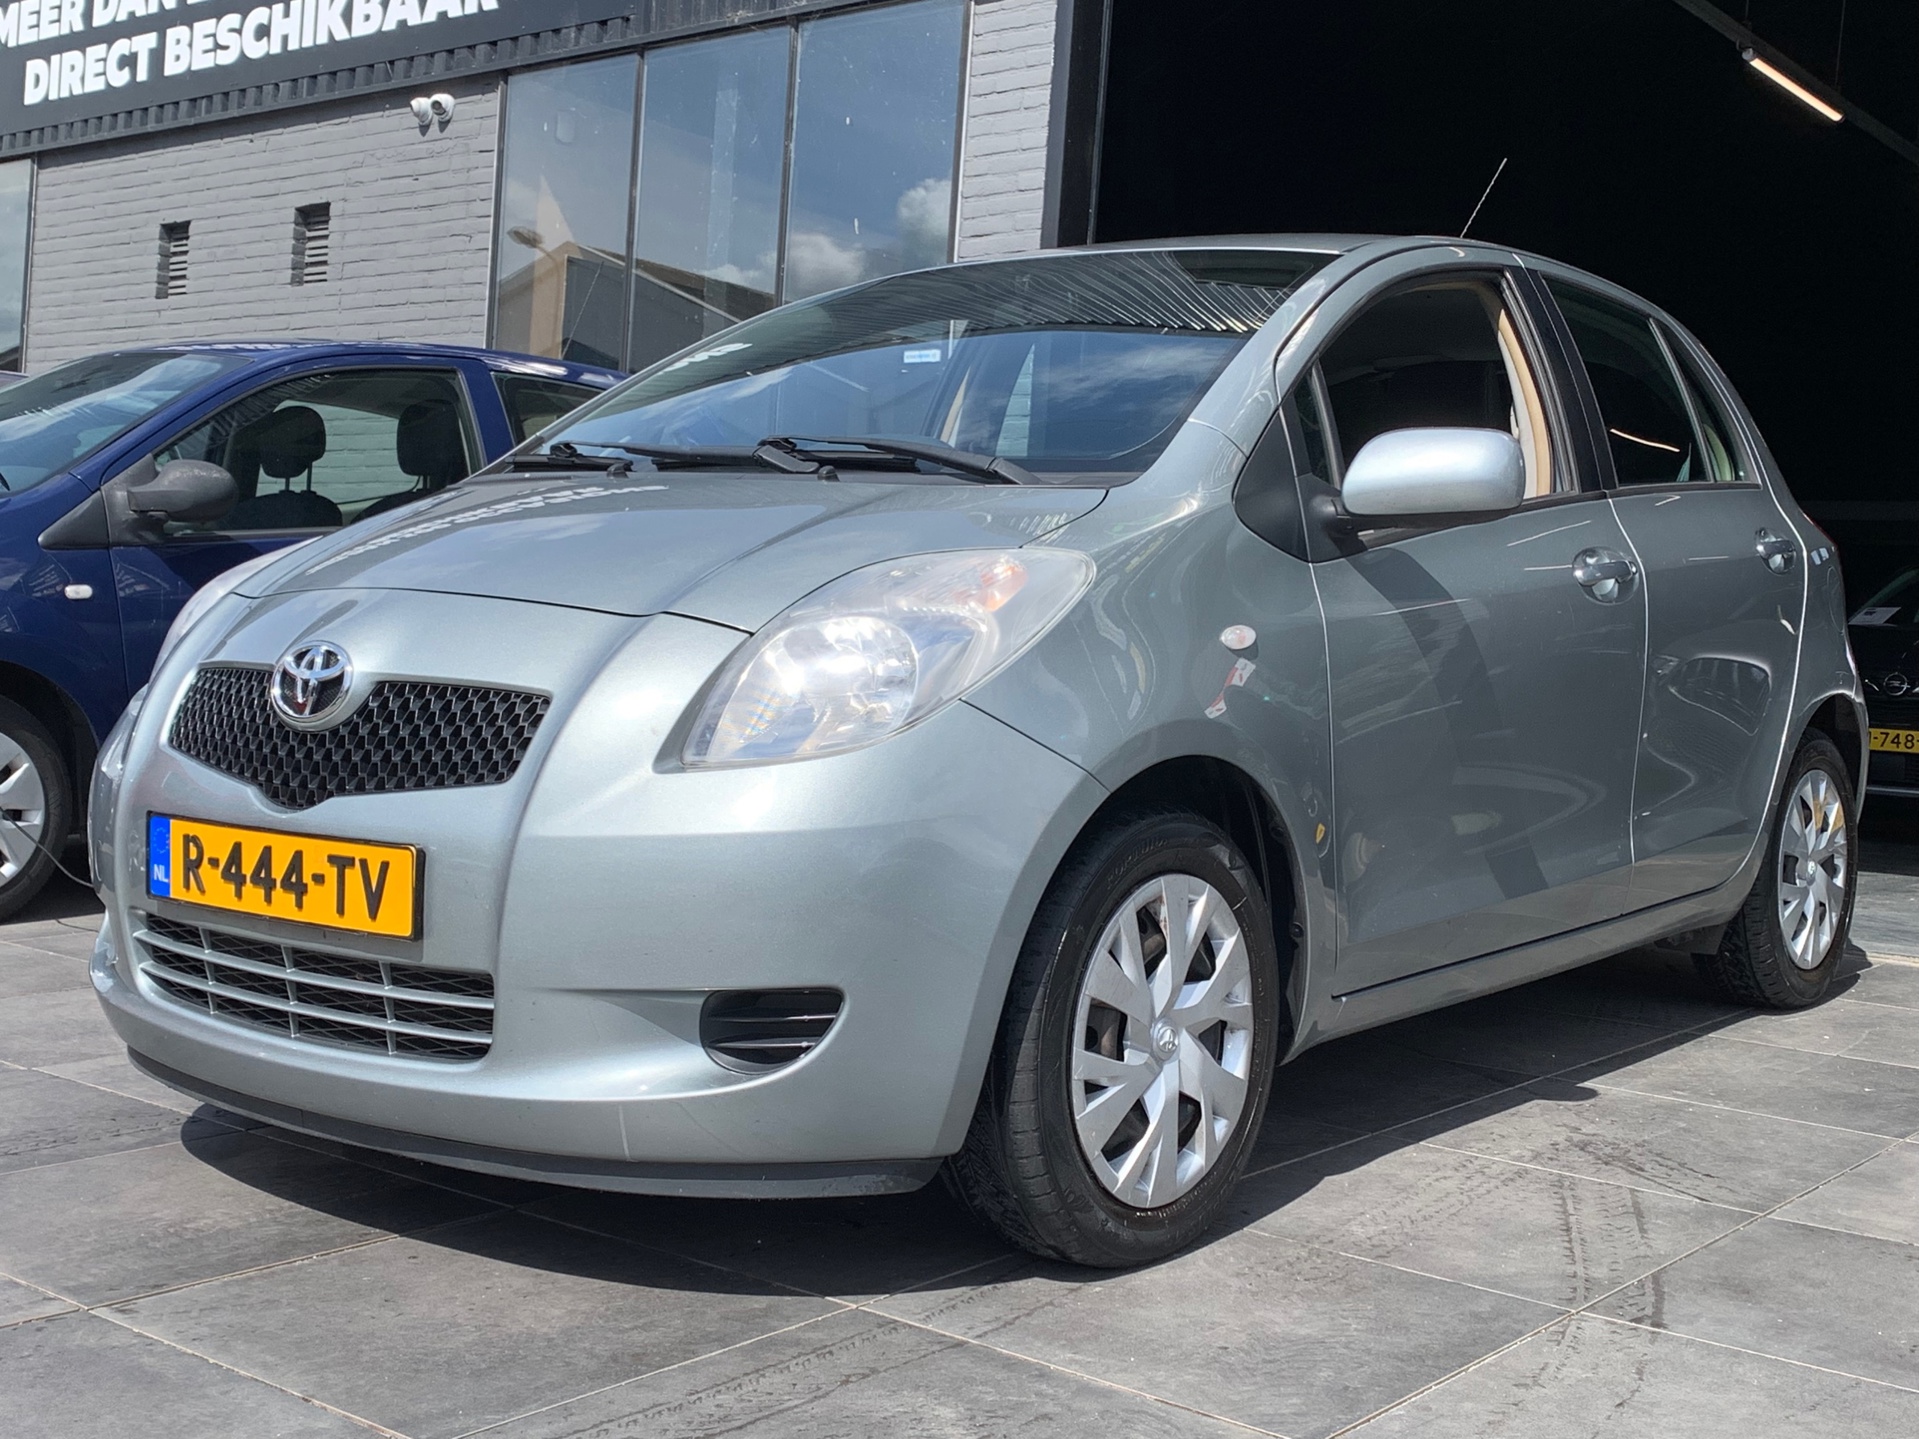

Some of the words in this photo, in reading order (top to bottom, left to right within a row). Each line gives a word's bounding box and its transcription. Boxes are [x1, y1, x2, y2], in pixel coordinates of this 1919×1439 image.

[0, 0, 86, 48] MEER
[23, 31, 158, 106] DIRECT
[1869, 730, 1919, 750] -748-
[153, 863, 169, 883] NL
[182, 833, 390, 922] R-444-TV
